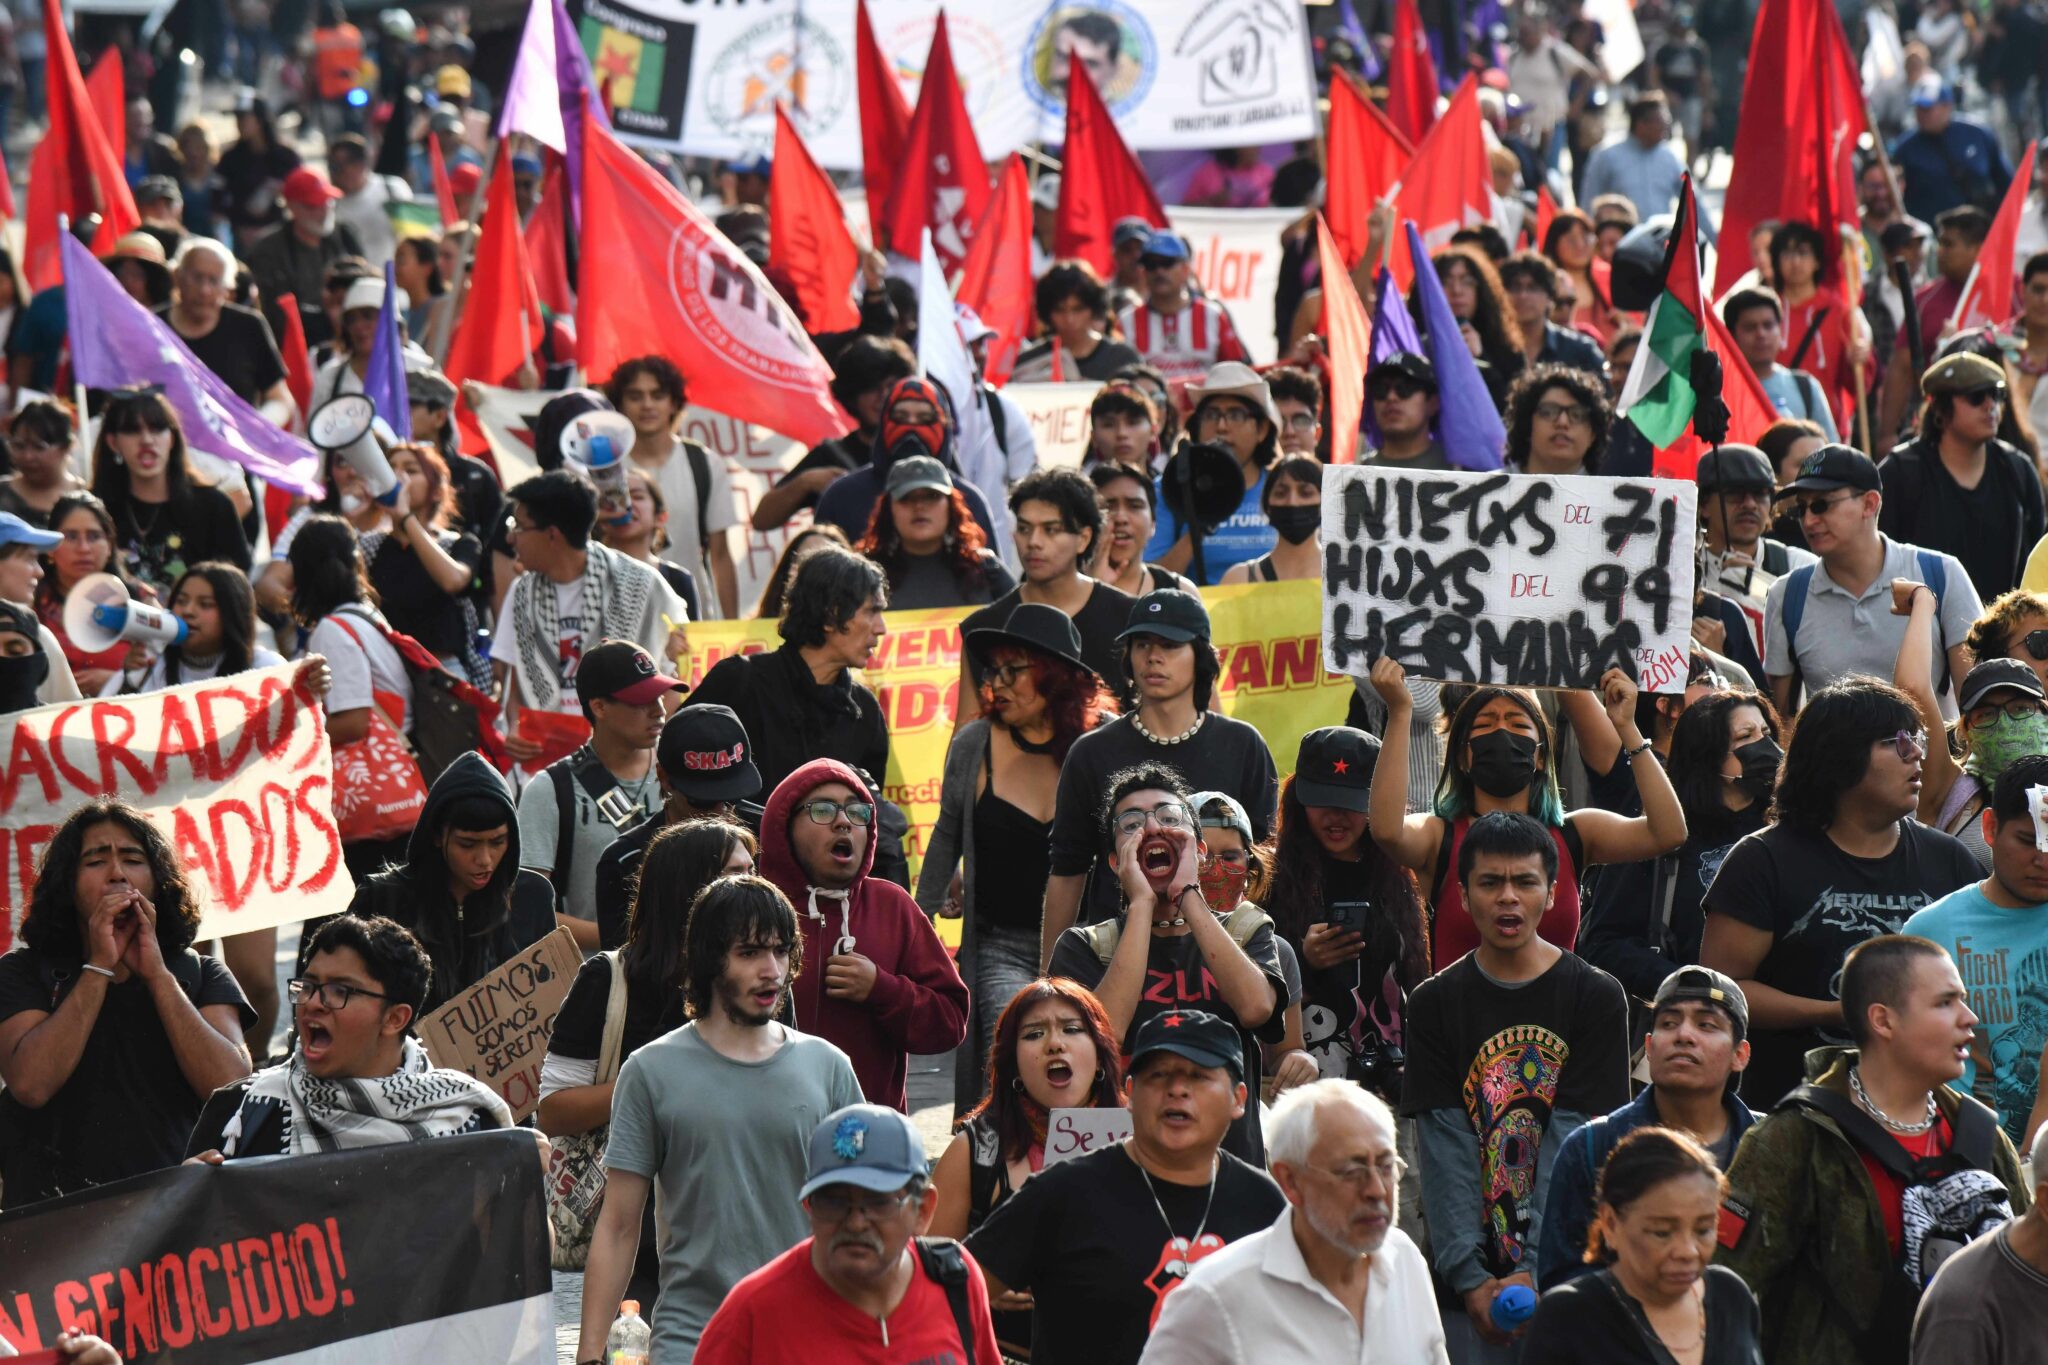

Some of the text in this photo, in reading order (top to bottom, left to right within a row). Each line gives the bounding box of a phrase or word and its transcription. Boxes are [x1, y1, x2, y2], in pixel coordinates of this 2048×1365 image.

[1343, 475, 1679, 568] NIETXS DEL 71
[1326, 541, 1674, 635] HIJXS DEL 99
[1635, 648, 1655, 664] DEL
[1641, 646, 1690, 692] 2014
[0, 676, 323, 813] ACRADOS
[684, 742, 743, 770] SKA-P
[1140, 966, 1220, 1005] ZLN
[1956, 936, 2010, 986] FIGHT
[475, 1001, 538, 1056] SOMOS
[1053, 1116, 1094, 1154] Se
[54, 1217, 355, 1361] GENOCIDIO!
